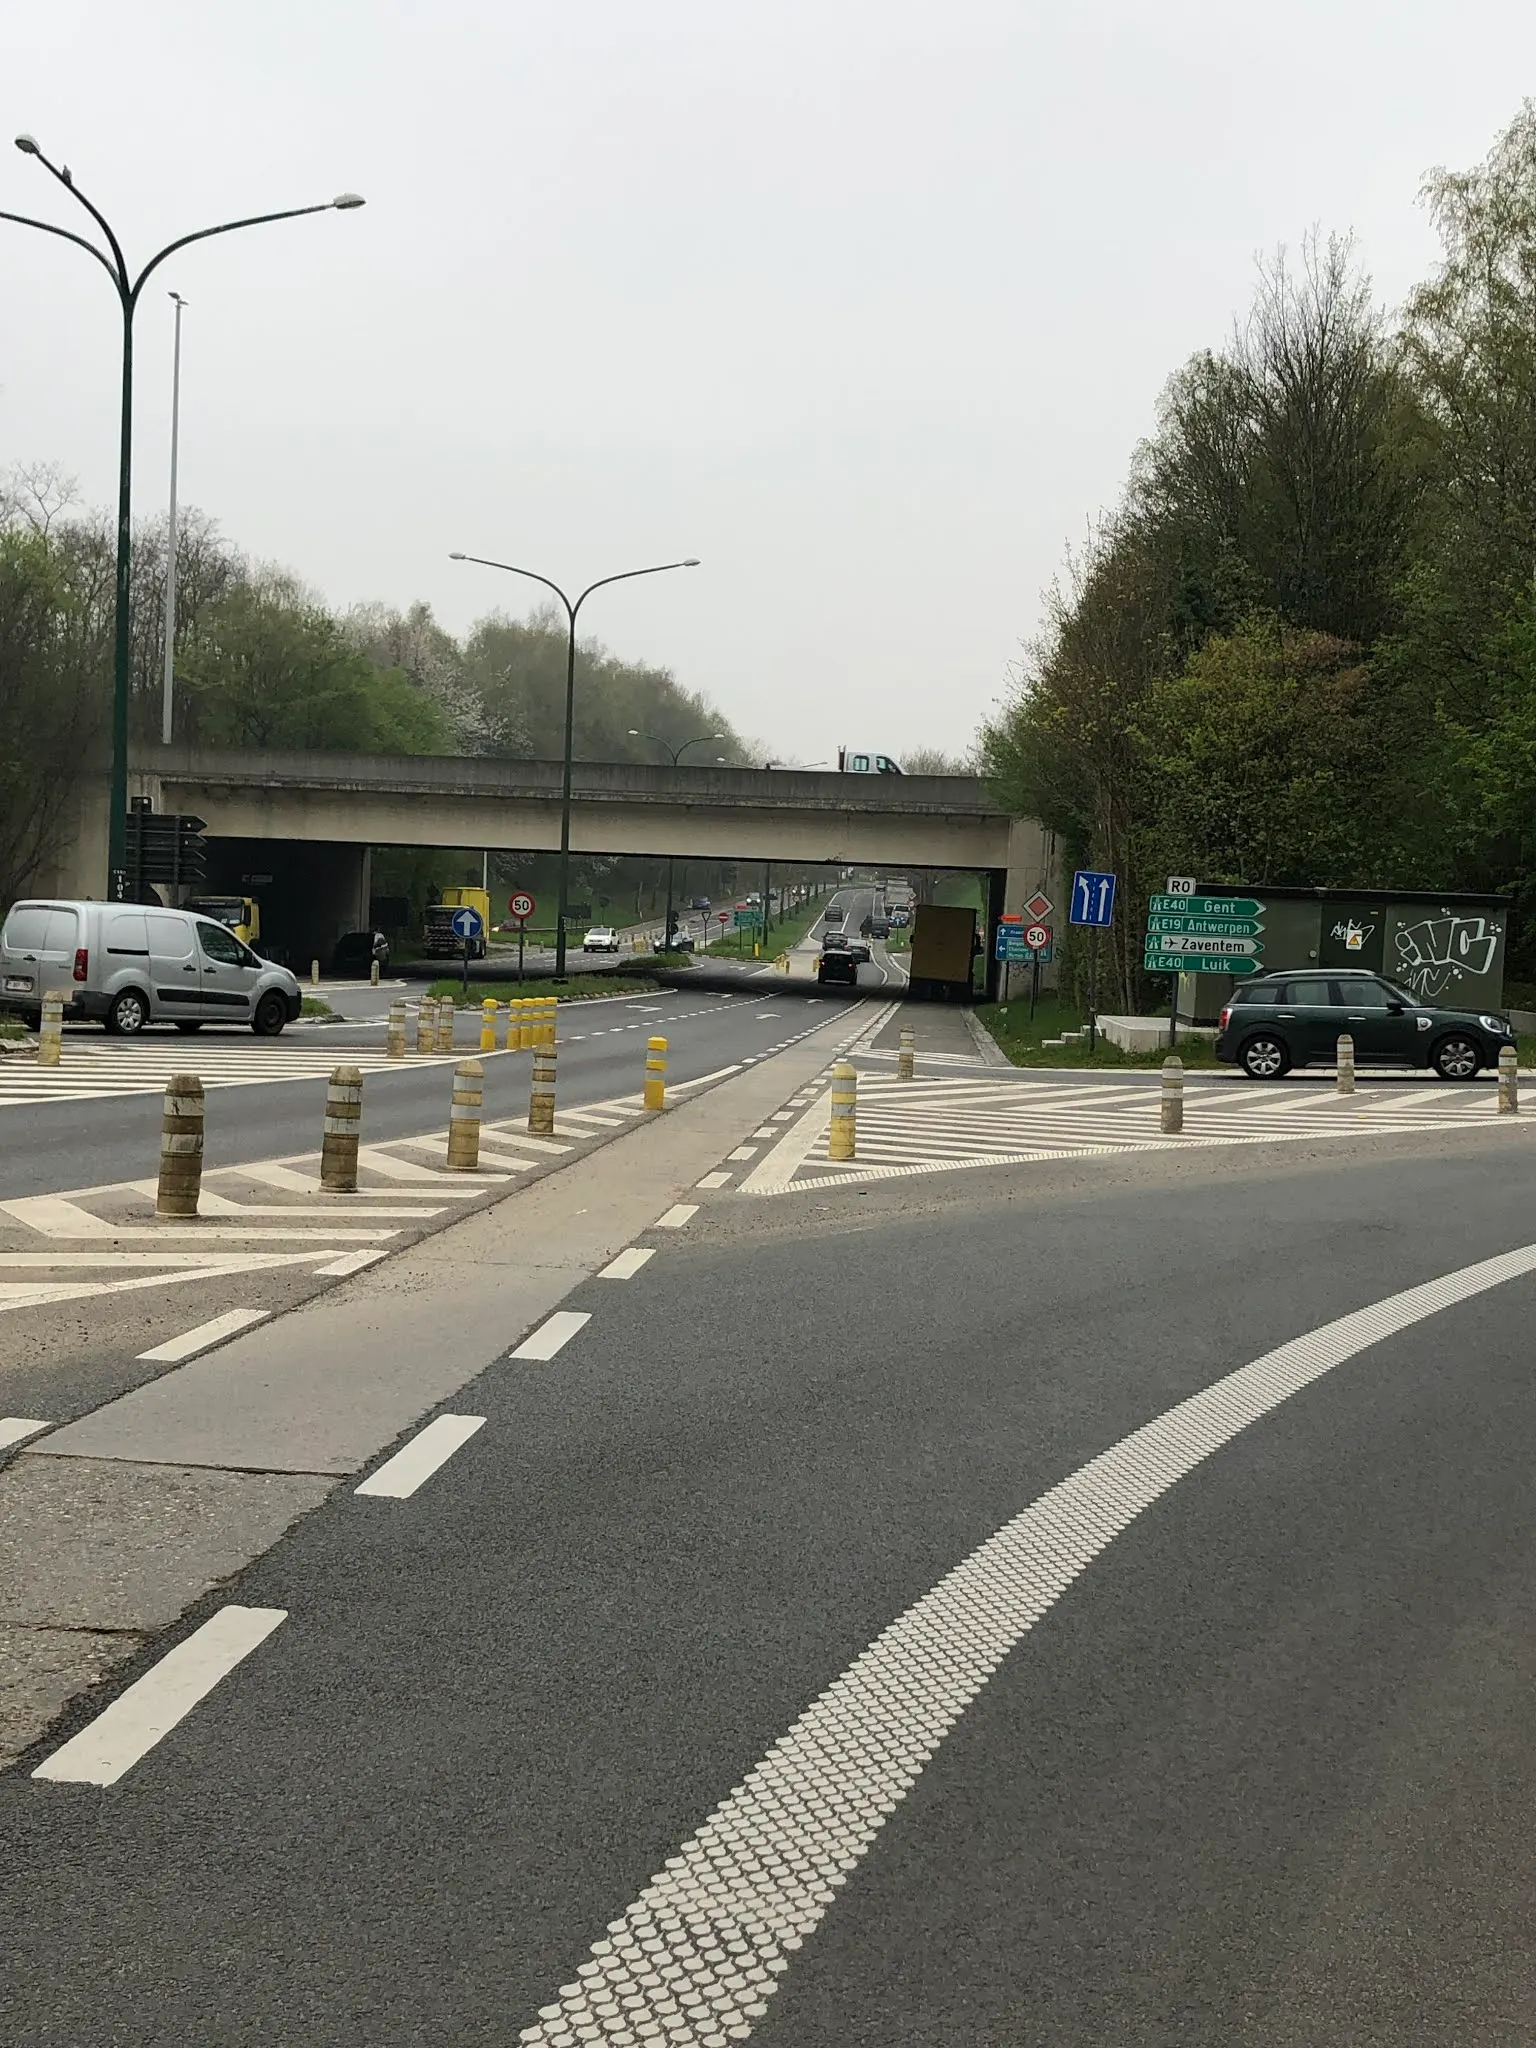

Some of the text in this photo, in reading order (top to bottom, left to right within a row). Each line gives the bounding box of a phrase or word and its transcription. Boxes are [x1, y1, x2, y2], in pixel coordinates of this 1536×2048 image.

[514, 900, 529, 911] 50
[1163, 899, 1235, 913] E40 Gent
[1161, 918, 1250, 936] E19 Antwerpen
[1029, 931, 1045, 942] 50
[1181, 937, 1245, 952] Zaventem
[1158, 957, 1231, 971] E40 Luik
